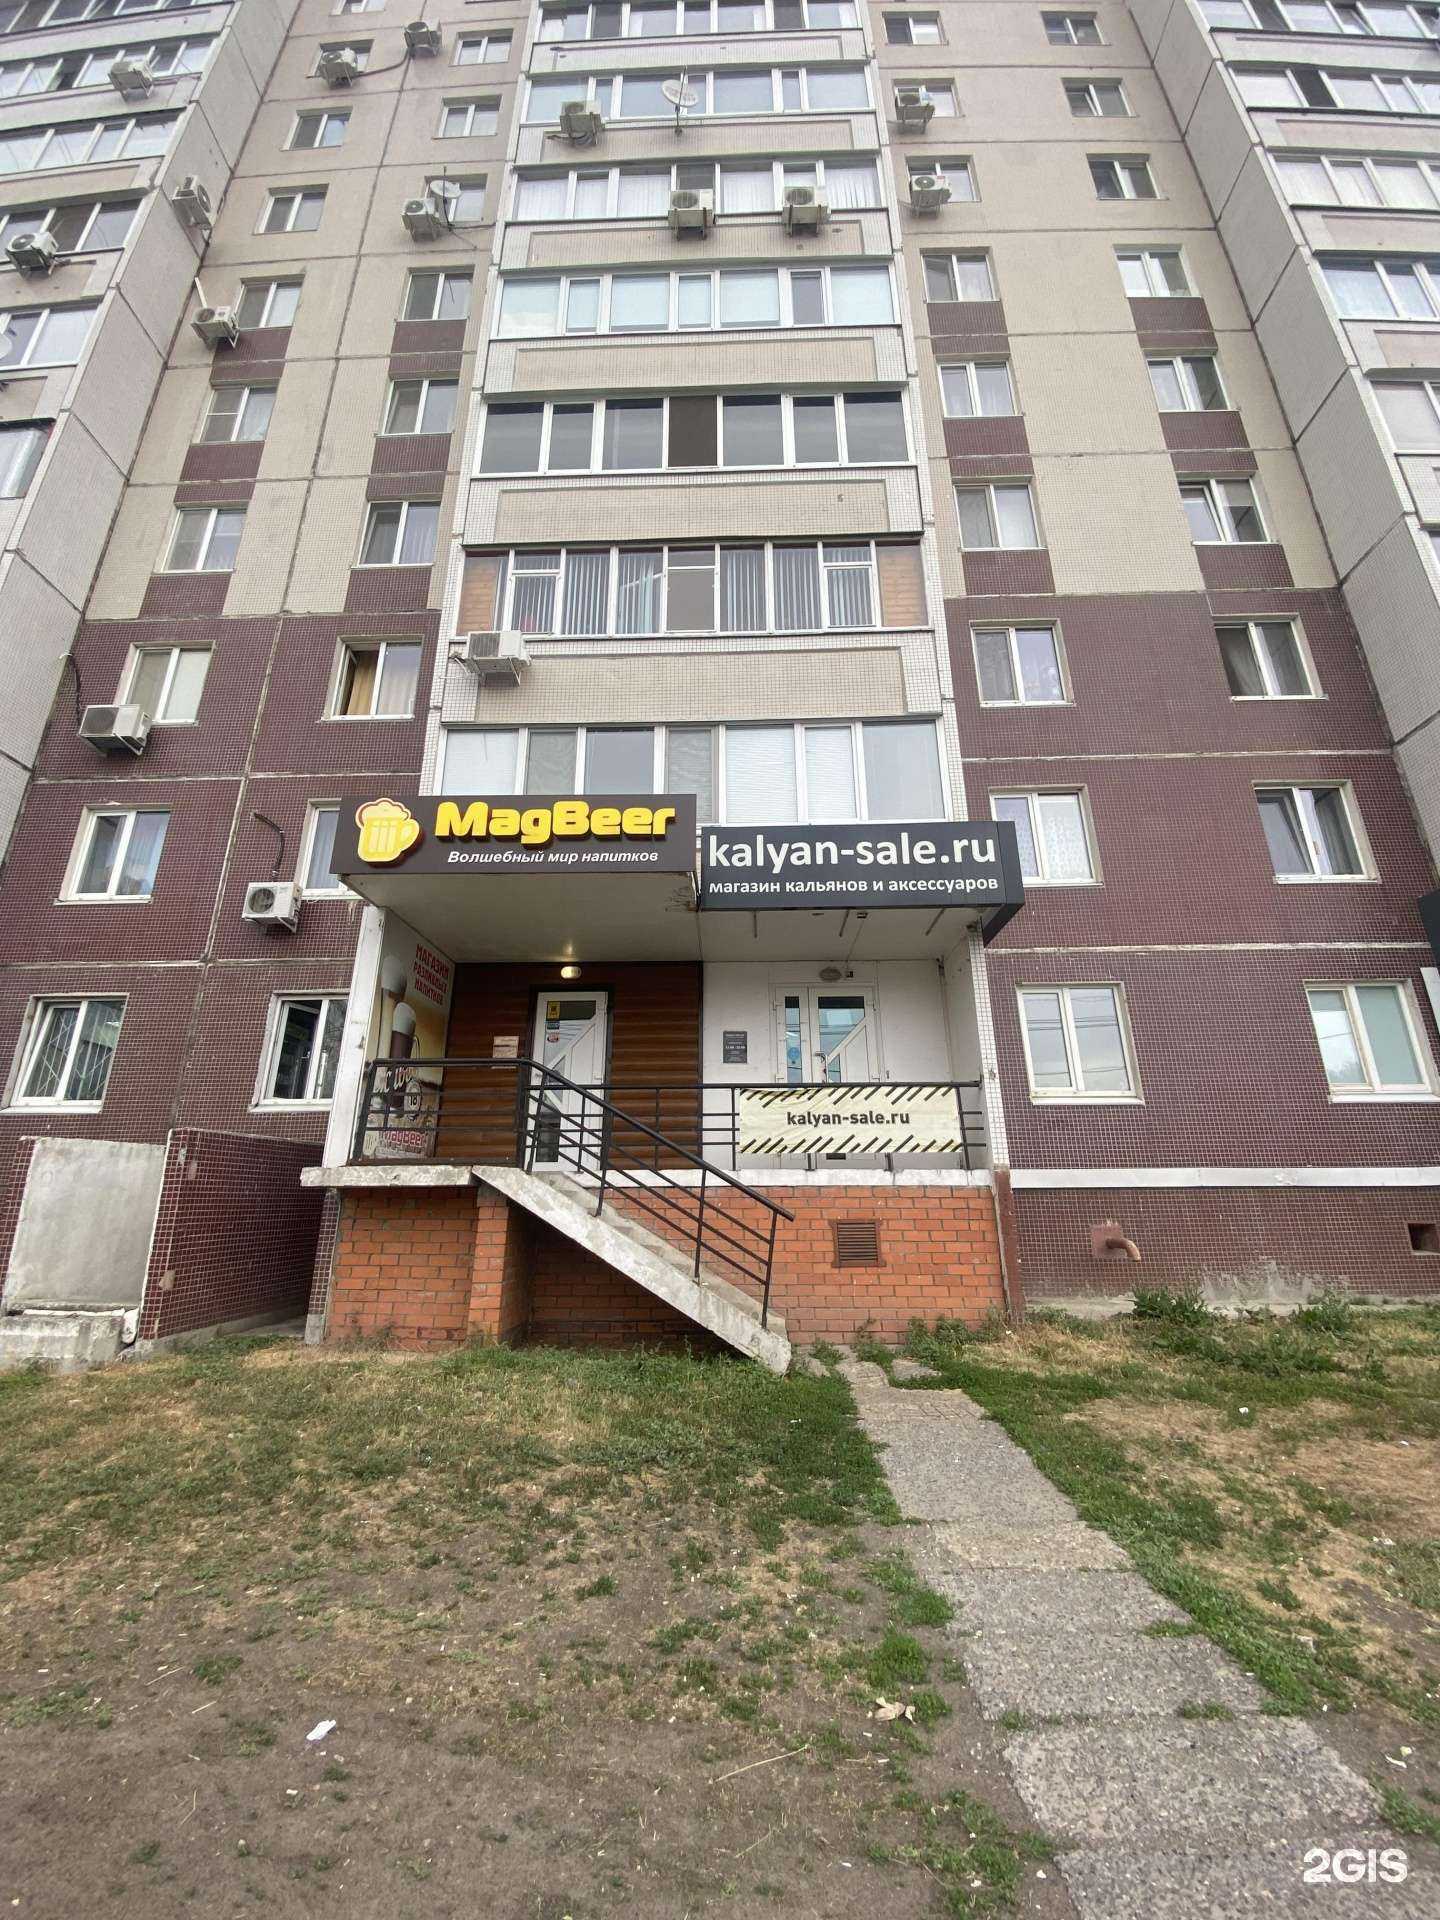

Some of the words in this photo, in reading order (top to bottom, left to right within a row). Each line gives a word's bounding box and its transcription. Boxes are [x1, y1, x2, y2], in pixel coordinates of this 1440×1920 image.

[434, 800, 676, 846] MagBeer
[447, 850, 544, 865] Волшебный
[547, 852, 579, 865] мир
[581, 851, 659, 863] напитков
[708, 831, 996, 874] kalyan-sale.ru
[709, 879, 781, 894] магазин
[785, 878, 867, 893] кальянов
[872, 879, 884, 891] и
[888, 877, 999, 894] аксессуаров
[416, 944, 449, 977] МАГАЗИН
[786, 1110, 910, 1129] kalyan-sale.ru
